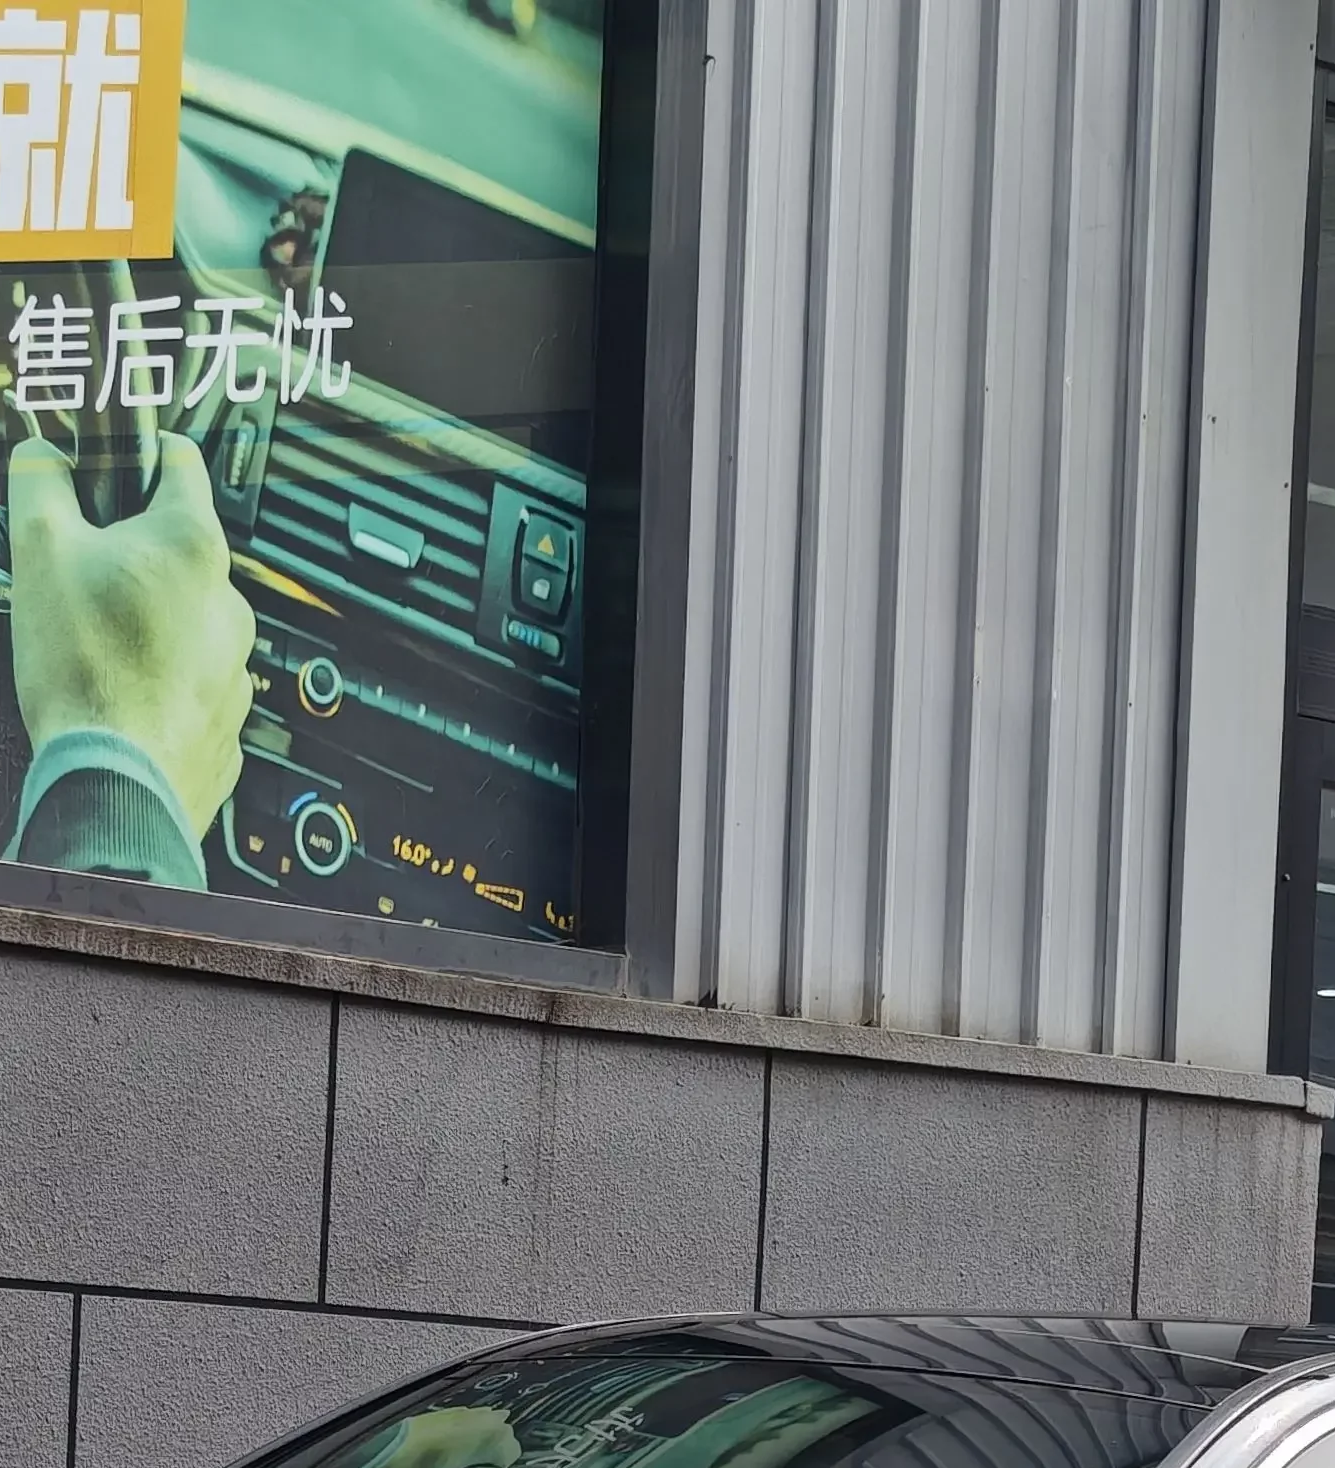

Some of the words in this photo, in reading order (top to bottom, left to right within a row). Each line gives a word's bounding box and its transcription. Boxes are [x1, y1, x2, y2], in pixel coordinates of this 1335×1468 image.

[7, 287, 354, 415] 售后无忧
[309, 833, 333, 853] AUTO
